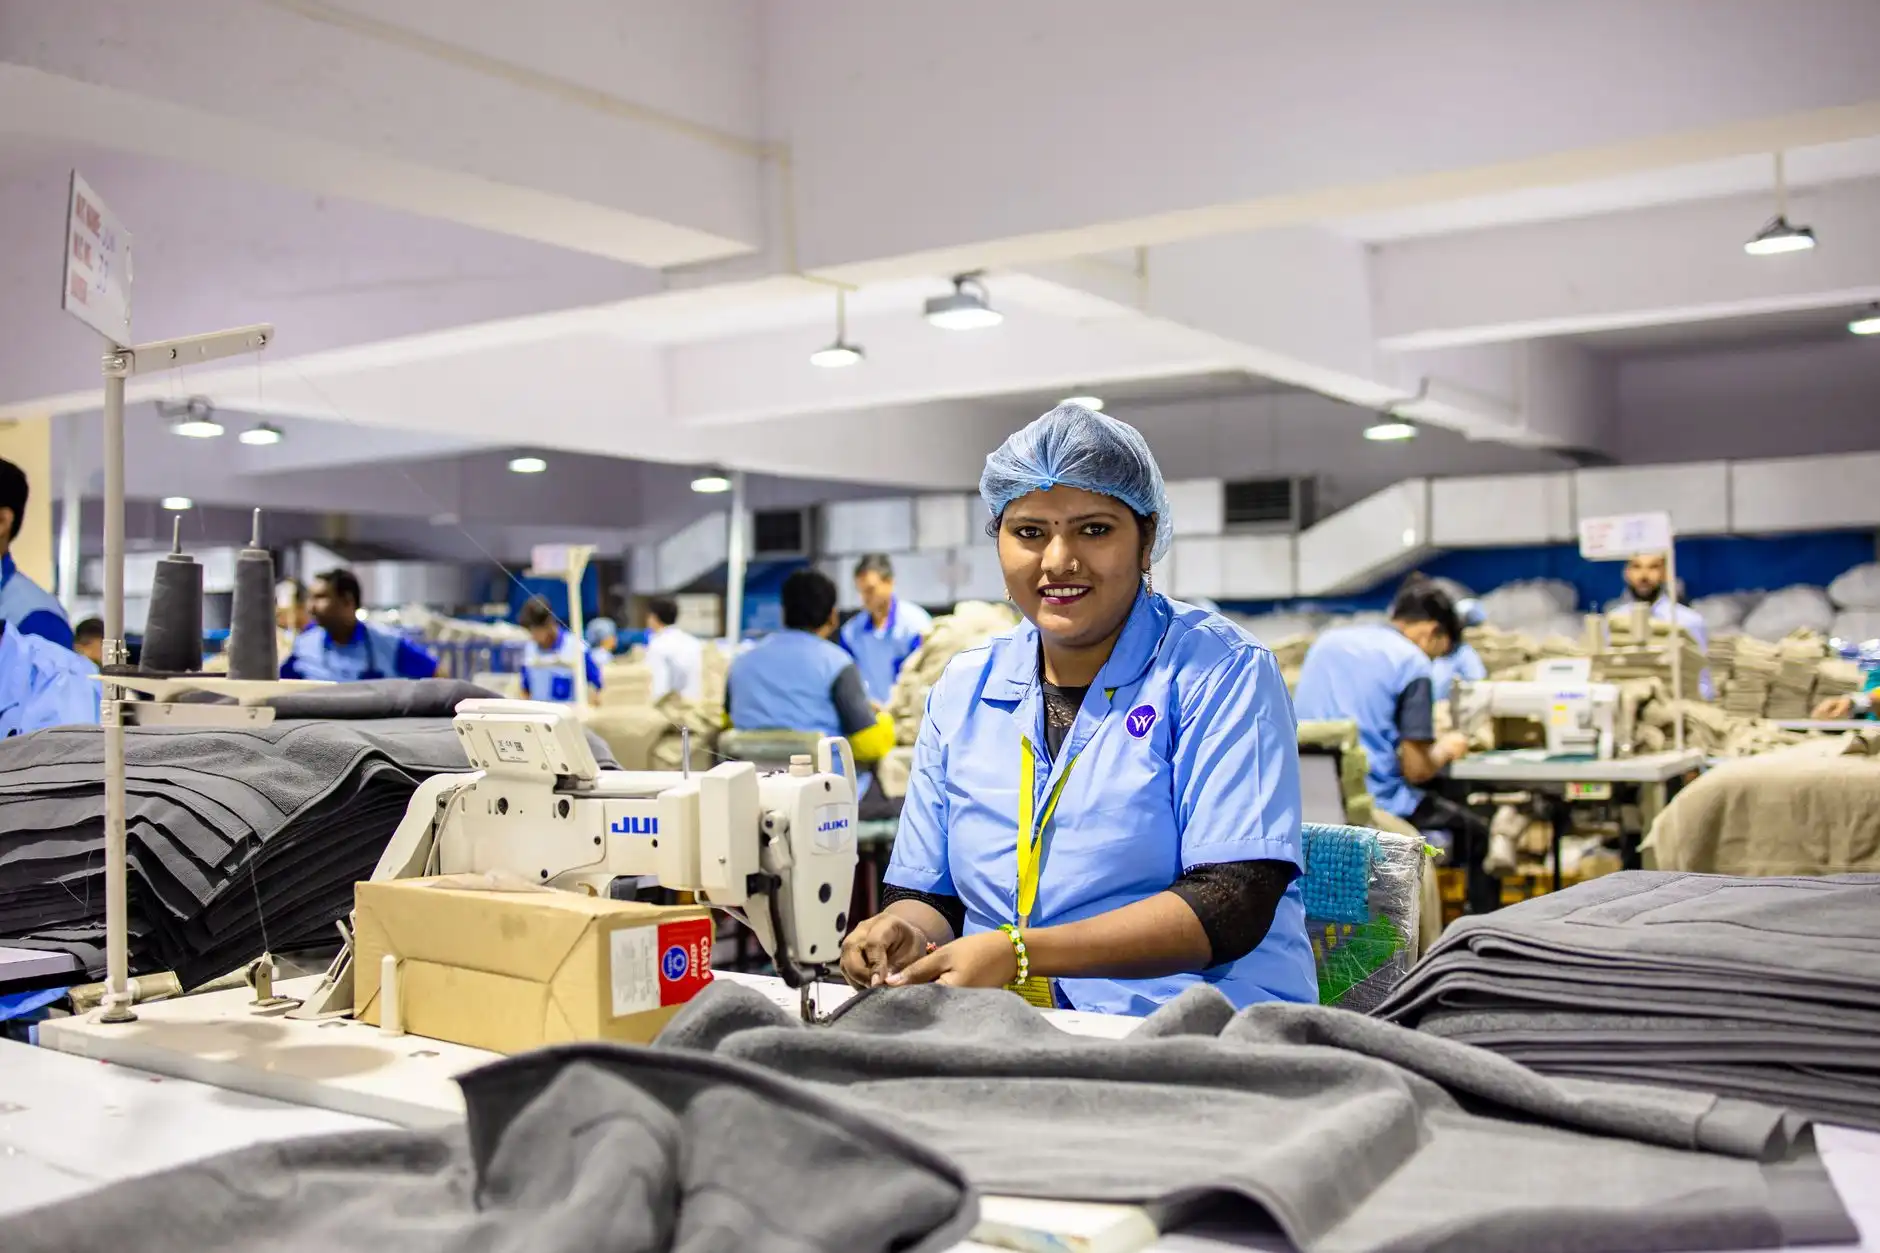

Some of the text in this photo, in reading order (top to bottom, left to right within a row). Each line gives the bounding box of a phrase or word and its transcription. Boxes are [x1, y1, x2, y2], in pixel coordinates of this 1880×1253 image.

[1130, 714, 1155, 732] W
[817, 818, 848, 832] JUKI
[700, 935, 711, 980] COATS
